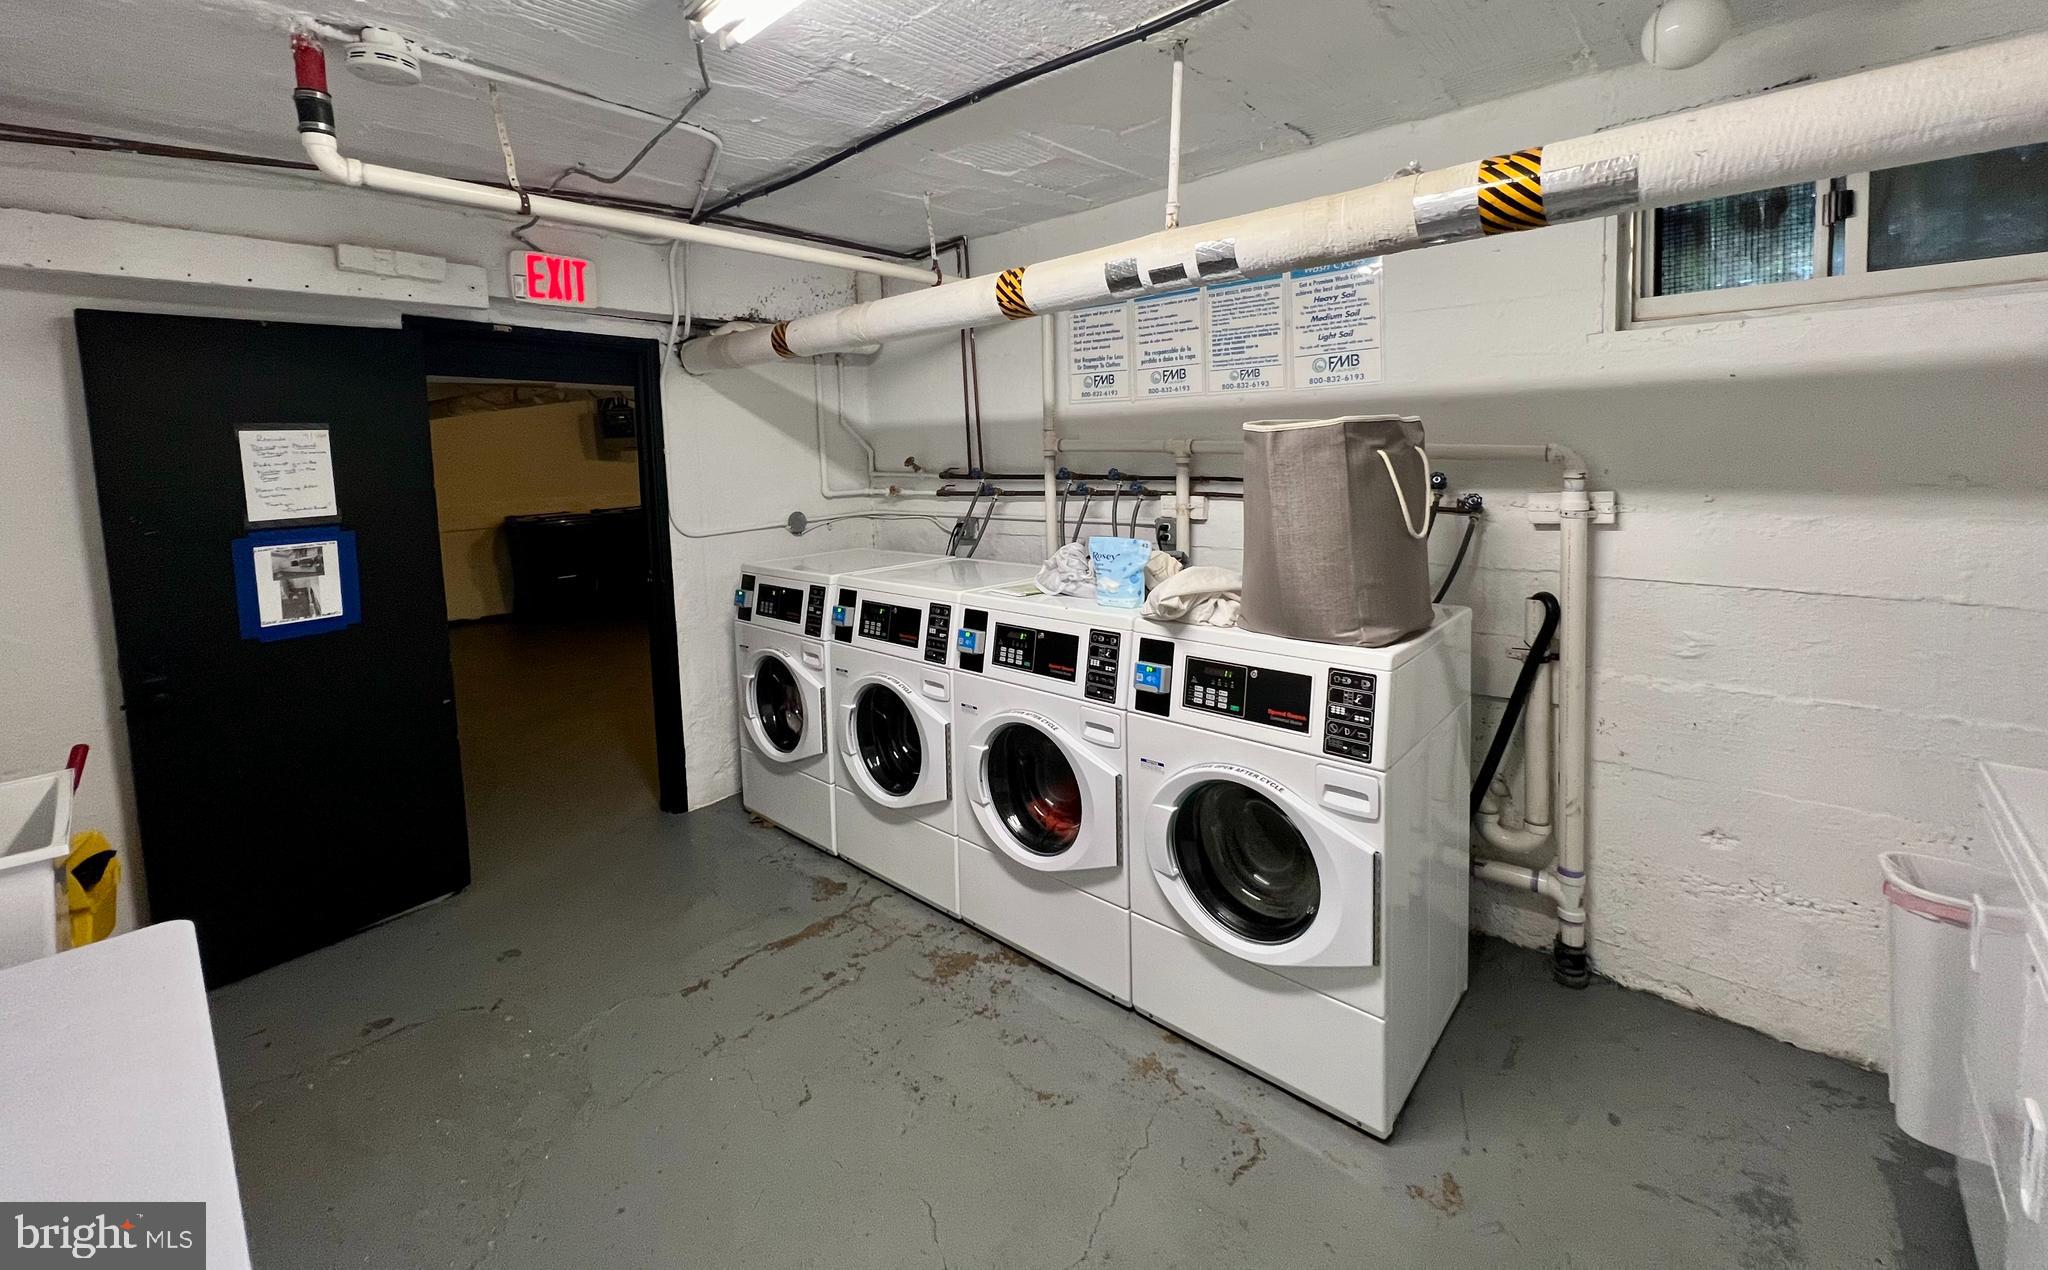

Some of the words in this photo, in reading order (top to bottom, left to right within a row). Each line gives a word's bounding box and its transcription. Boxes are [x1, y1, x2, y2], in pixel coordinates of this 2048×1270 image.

[526, 254, 587, 303] EXIT
[1313, 278, 1334, 287] Premium
[1313, 295, 1340, 304] Heavy
[1341, 289, 1357, 300] Soil
[1310, 312, 1343, 323] Medium
[1345, 308, 1361, 318] Soil
[1318, 331, 1337, 342] Light
[1338, 329, 1354, 339] Soil
[1328, 353, 1360, 373] FMB
[1093, 374, 1115, 388] FMB
[1162, 368, 1187, 384] FMB
[1239, 368, 1261, 382] FMB
[1308, 373, 1365, 385] 800-832-6193
[1148, 384, 1190, 395] 800-832-6193
[1221, 380, 1270, 391] 800-832-6193
[1092, 551, 1121, 563] Rosey
[1234, 768, 1260, 779] AFTER
[1259, 776, 1285, 792] CYCLE
